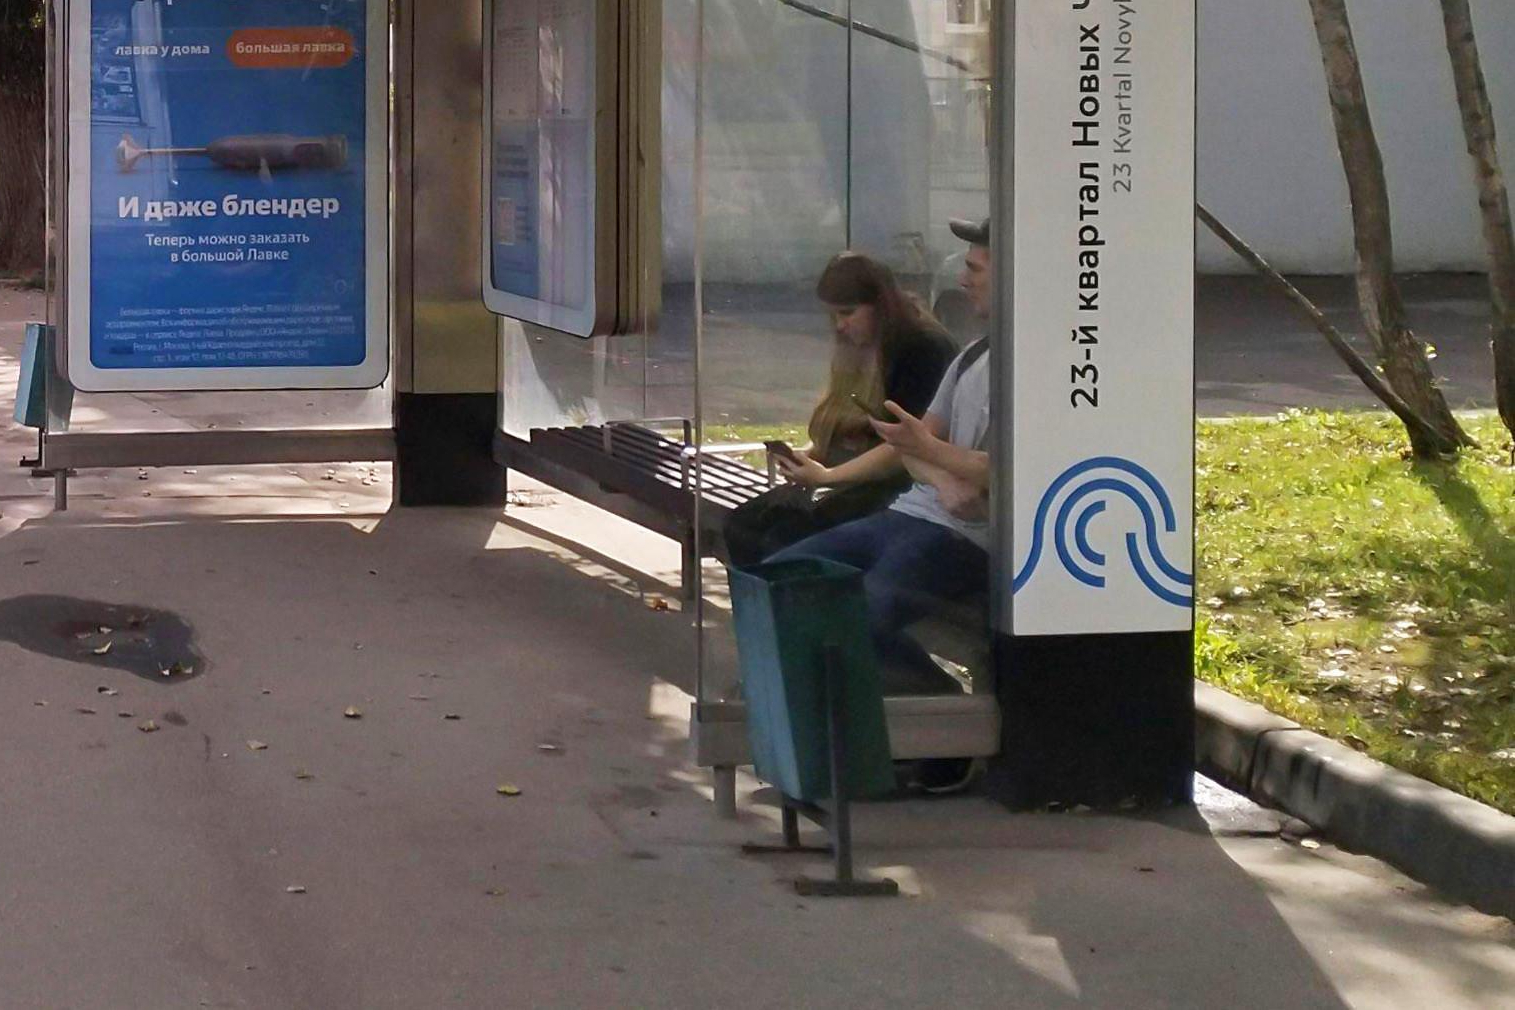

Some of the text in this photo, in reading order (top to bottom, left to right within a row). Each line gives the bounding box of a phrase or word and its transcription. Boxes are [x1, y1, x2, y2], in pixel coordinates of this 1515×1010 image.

[115, 44, 210, 57] лавка у дома
[235, 41, 346, 54] большая лавка
[1072, 24, 1100, 146] Новых
[1113, 74, 1132, 153] Kvartal
[1113, 162, 1132, 193] 23
[118, 194, 340, 222] И даже блендер
[145, 232, 310, 248] Теперь можно заказать
[1078, 162, 1106, 311] квартал
[171, 247, 289, 262] в большой Лавке
[1070, 325, 1099, 408] 23-й
